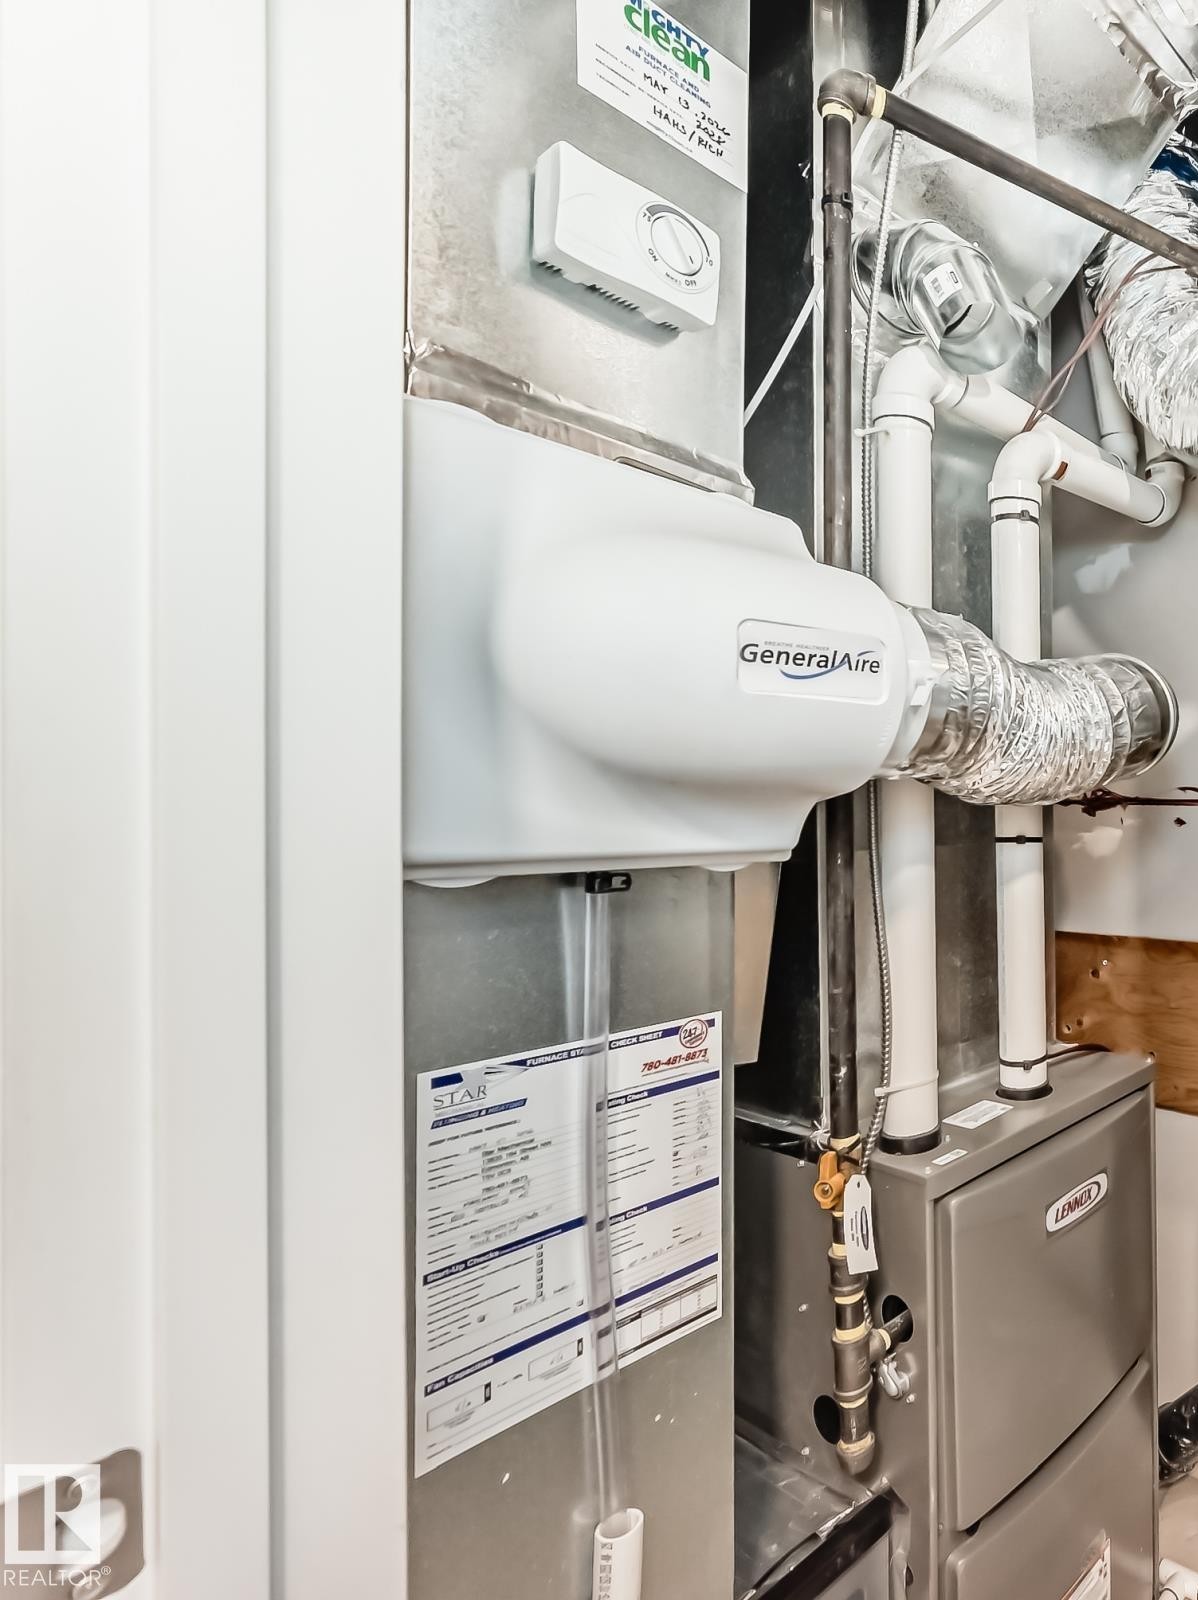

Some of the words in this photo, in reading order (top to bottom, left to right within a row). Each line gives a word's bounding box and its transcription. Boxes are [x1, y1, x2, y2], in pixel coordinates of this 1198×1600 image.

[624, 5, 710, 82] clean
[626, 45, 641, 59] AIR
[643, 57, 666, 76] DUCT
[670, 76, 711, 108] CLEANING
[639, 45, 679, 78] FURNACE
[683, 78, 699, 92] AND
[644, 73, 668, 94] MAY
[648, 248, 658, 261] ON
[739, 643, 881, 674] GeneralAire
[526, 1051, 568, 1067] FURNACE
[610, 1037, 638, 1048] CHECK
[638, 1031, 663, 1042] SHEET
[640, 1048, 708, 1072] 780-481-8873
[433, 1085, 487, 1109] STAR
[626, 1090, 648, 1101] Check
[1055, 1186, 1093, 1224] LENNOX
